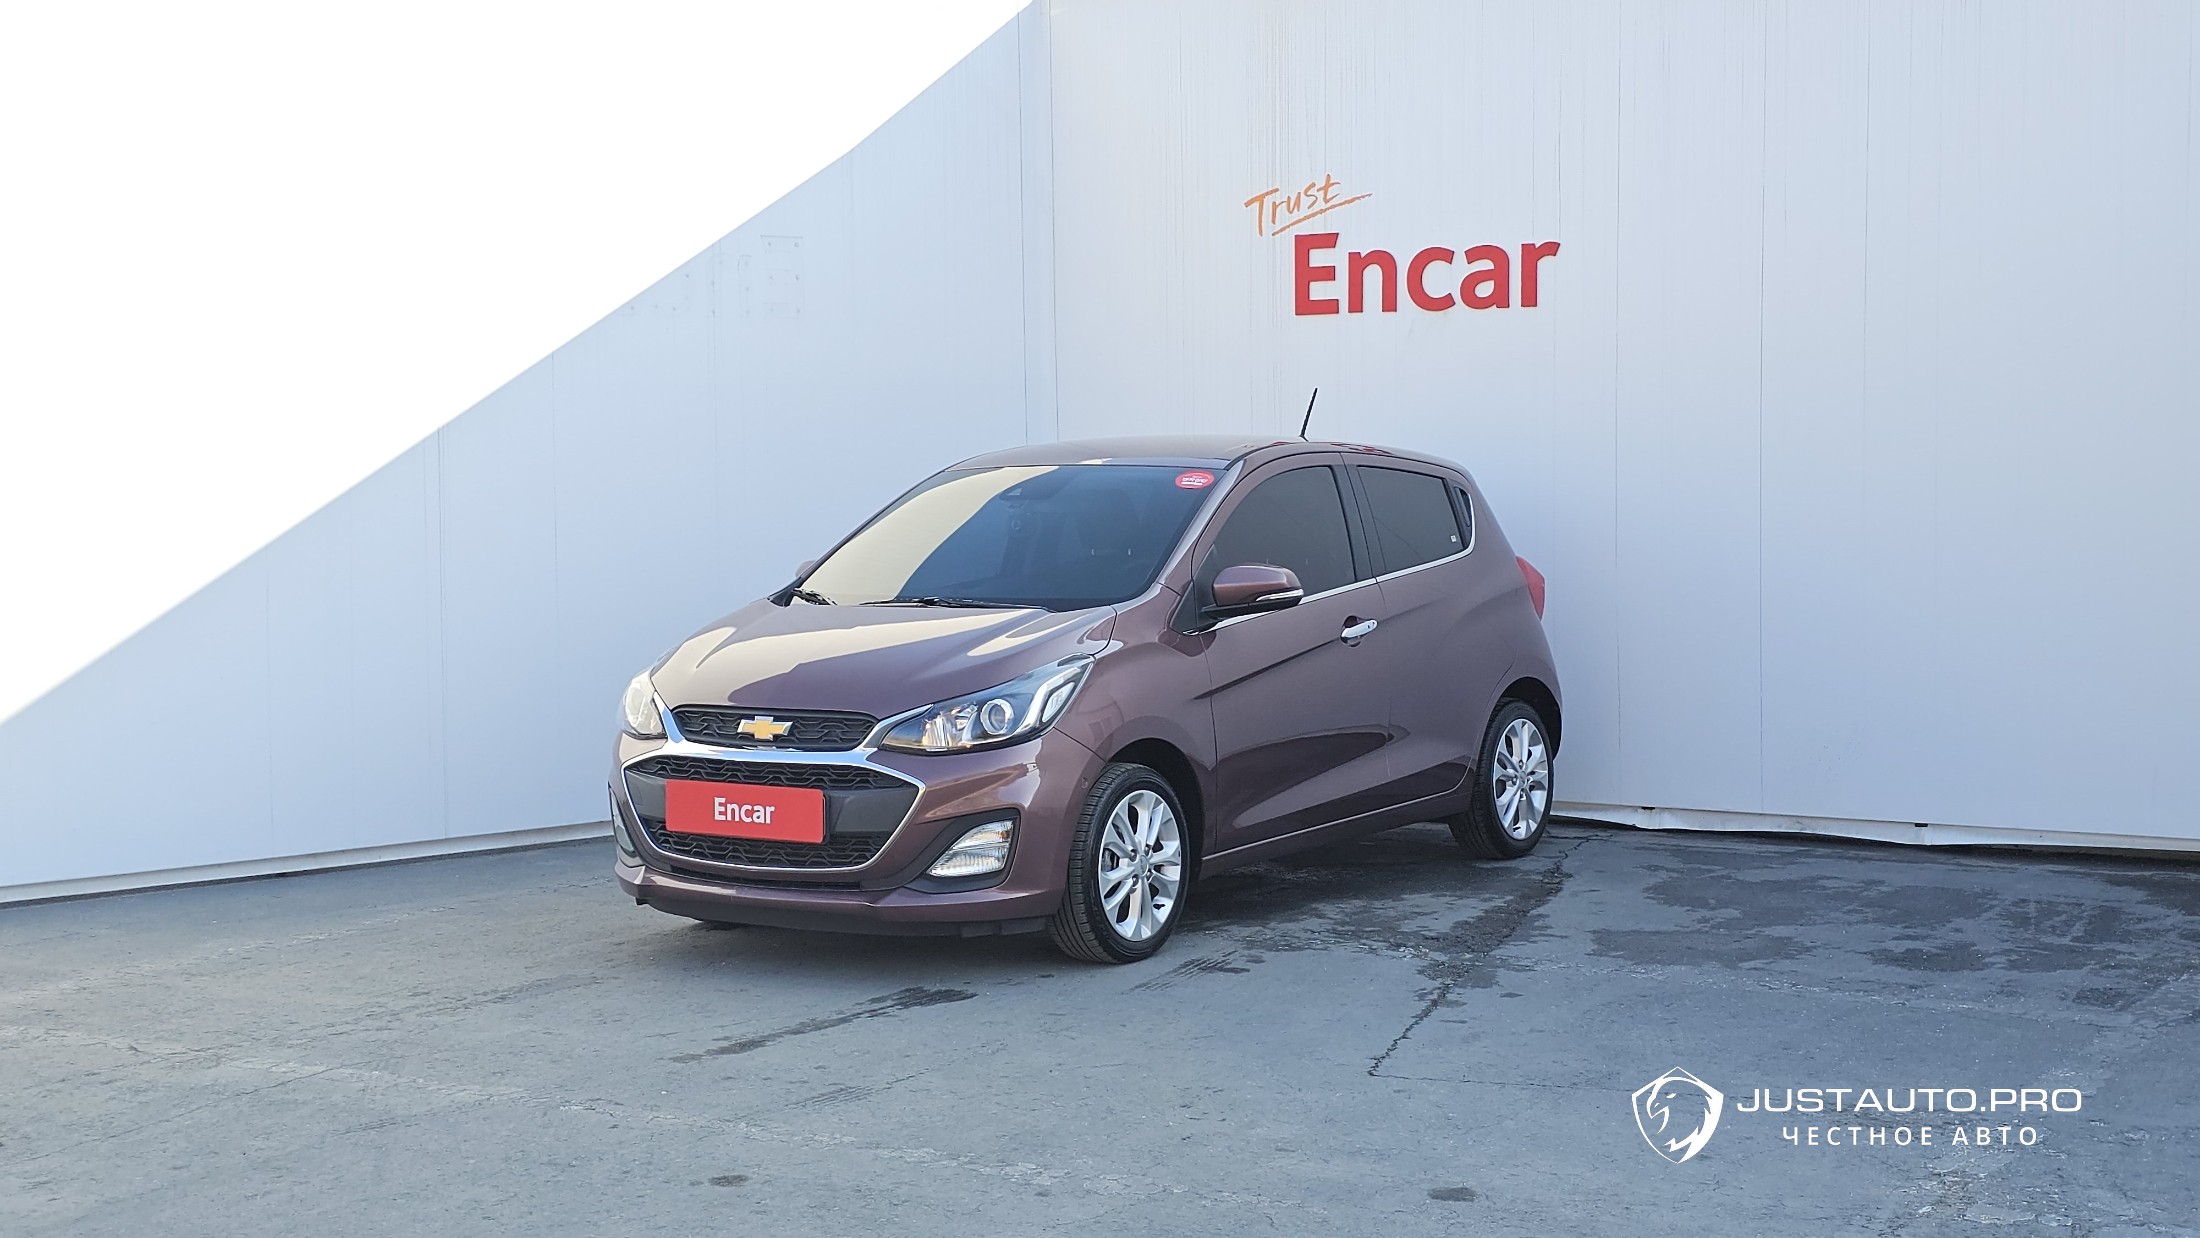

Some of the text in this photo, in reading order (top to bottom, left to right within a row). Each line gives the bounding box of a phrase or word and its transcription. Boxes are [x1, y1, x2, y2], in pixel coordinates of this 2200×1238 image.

[1244, 173, 1341, 237] Trust
[1294, 232, 1561, 316] Encar
[713, 796, 775, 824] Encar
